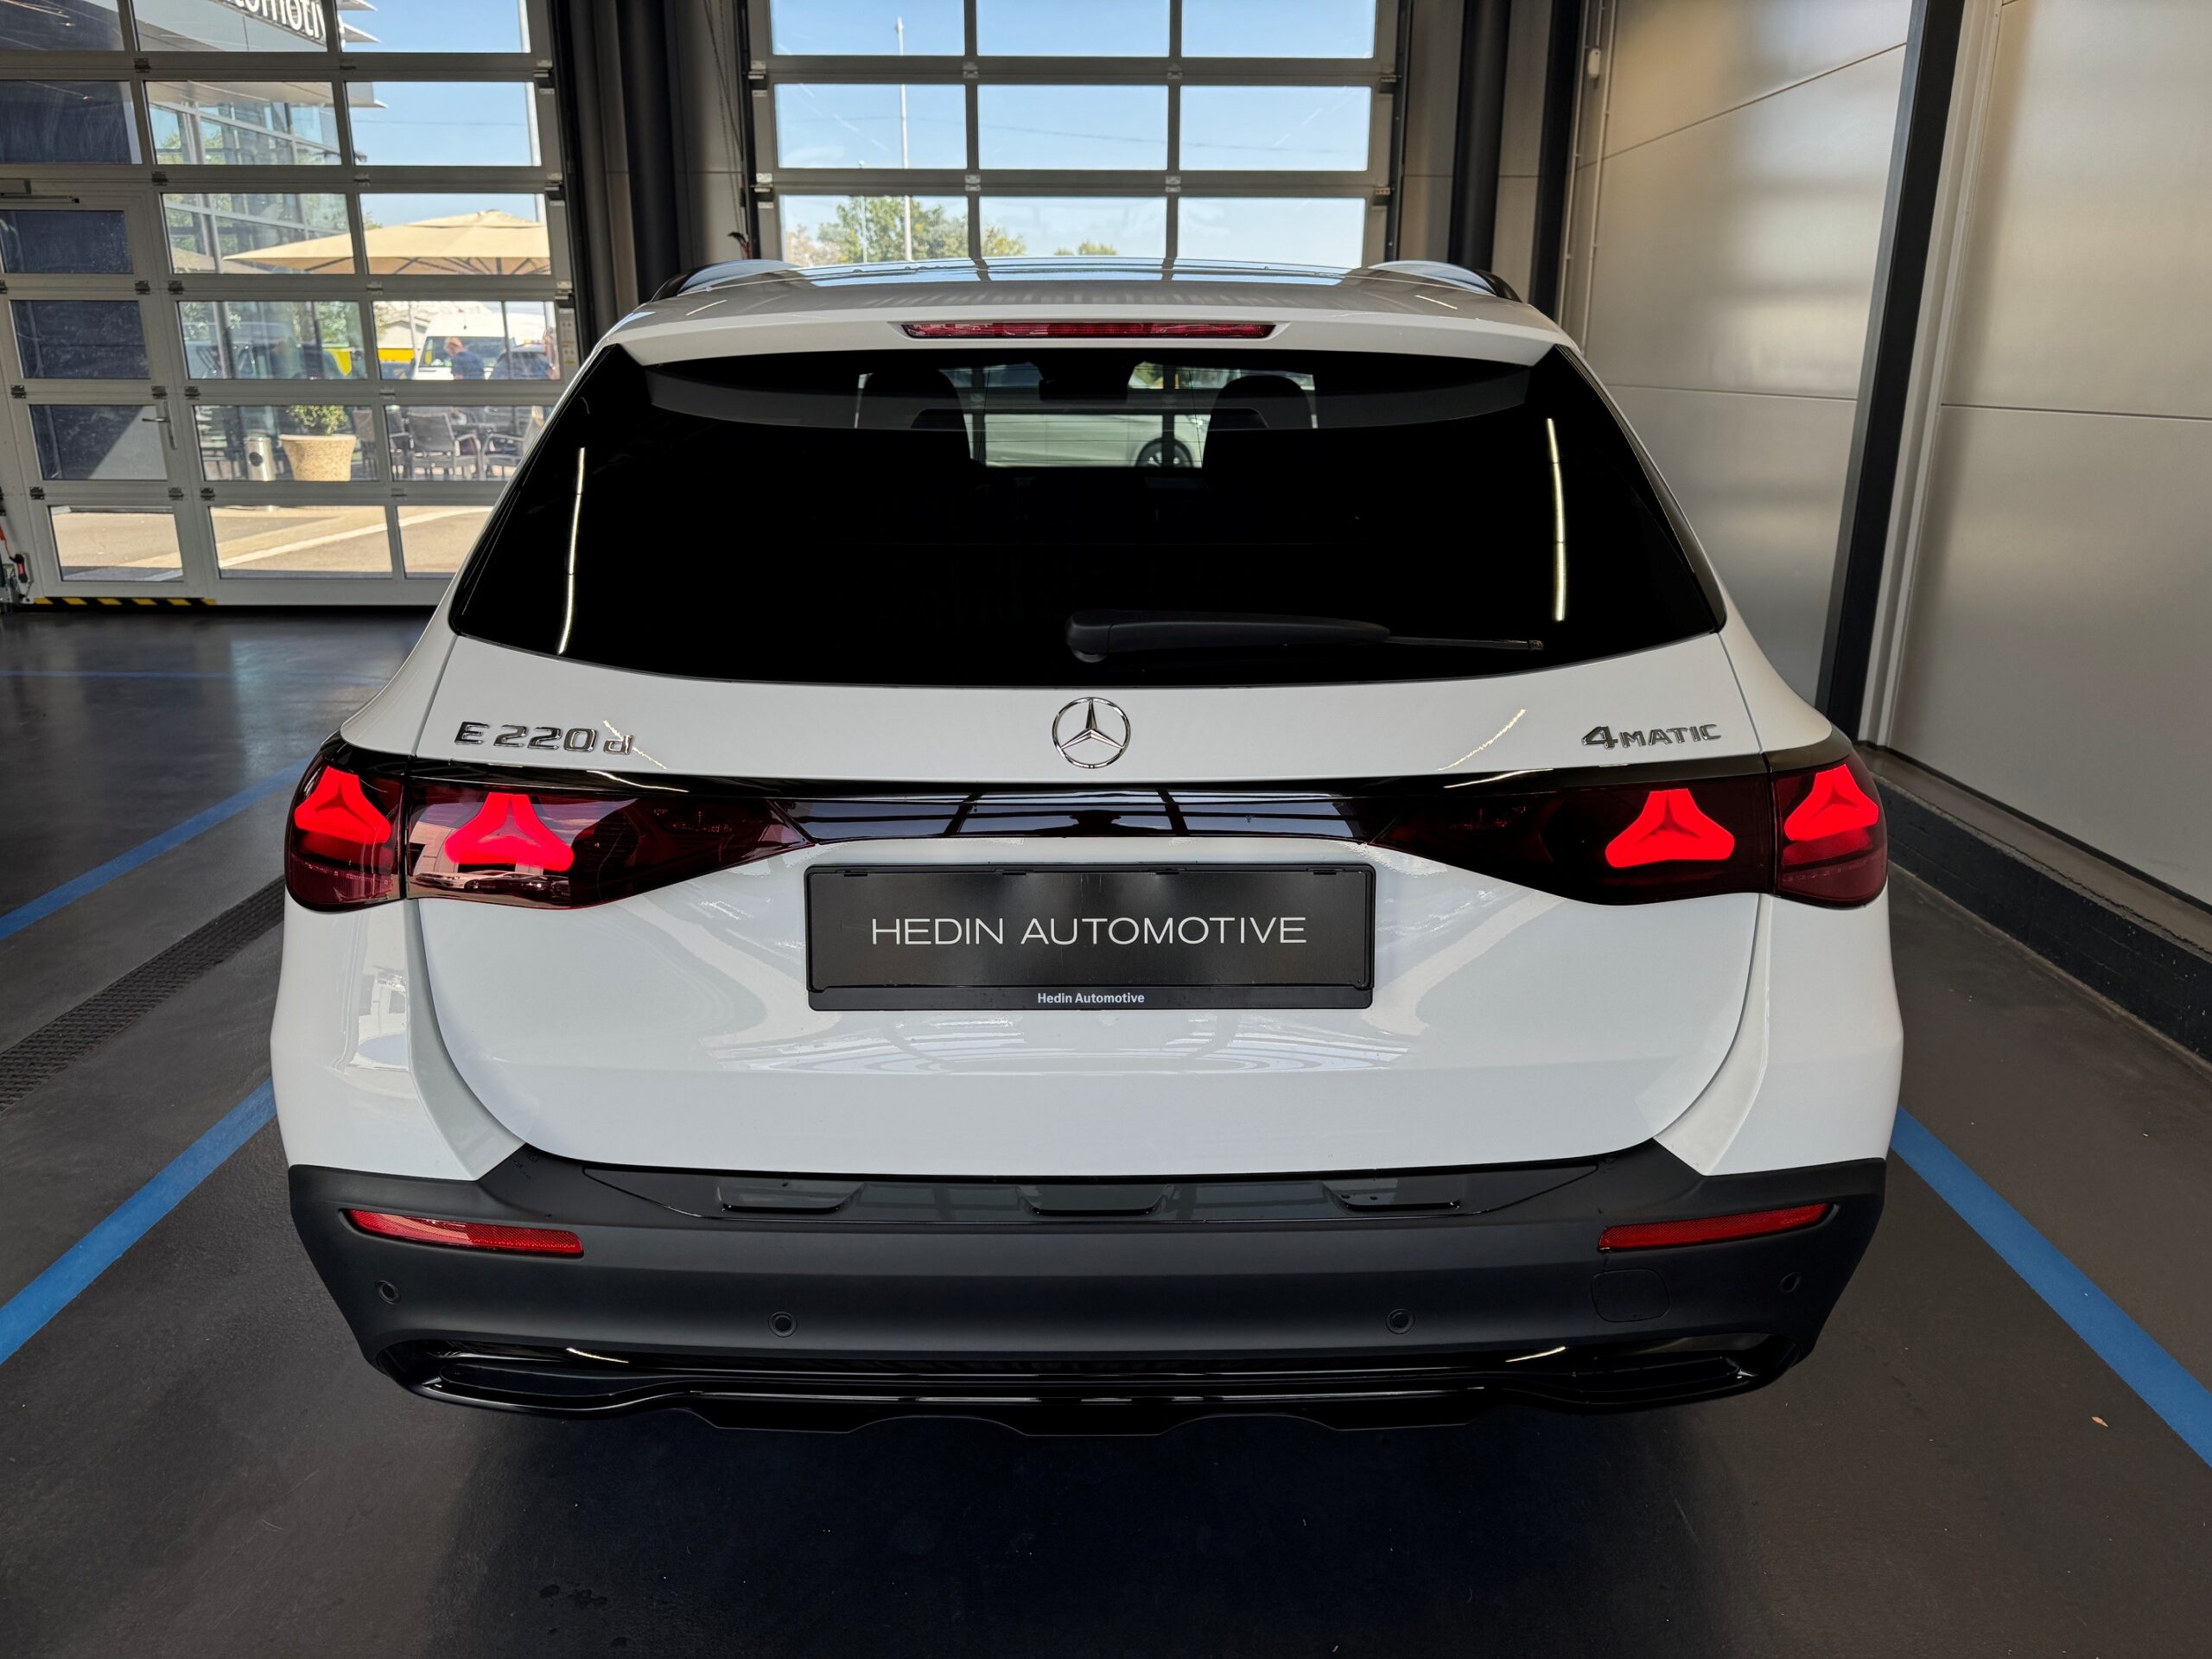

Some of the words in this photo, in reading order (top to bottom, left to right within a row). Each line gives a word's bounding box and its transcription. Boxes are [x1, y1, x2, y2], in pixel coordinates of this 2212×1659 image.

[454, 721, 490, 745] E
[1582, 724, 1721, 749] 4MATIC
[872, 918, 1003, 945] HEDIN
[1020, 916, 1307, 945] AUTOMOTIVE
[1037, 992, 1072, 1004] Hedin
[1074, 992, 1145, 1004] Automotive
